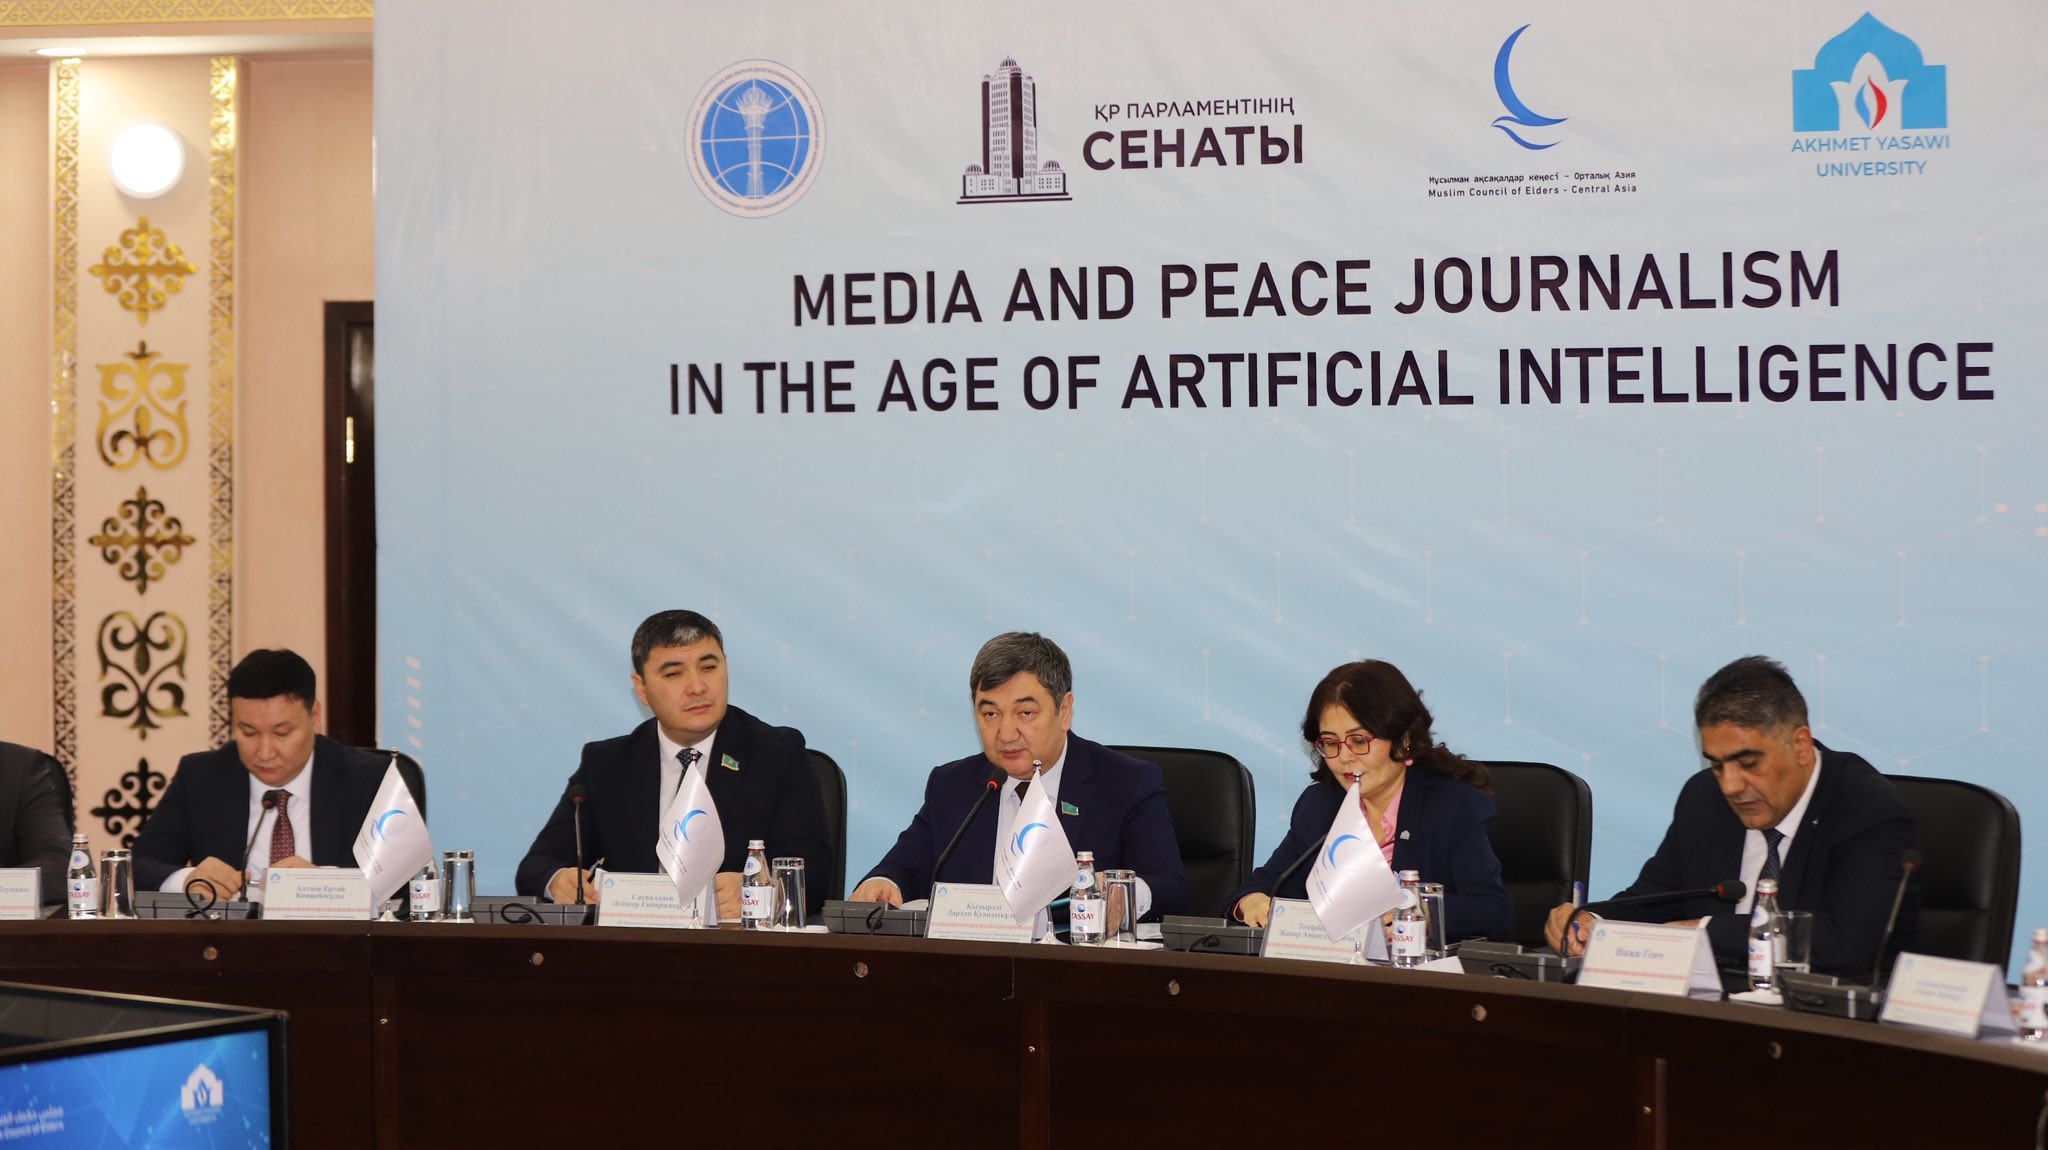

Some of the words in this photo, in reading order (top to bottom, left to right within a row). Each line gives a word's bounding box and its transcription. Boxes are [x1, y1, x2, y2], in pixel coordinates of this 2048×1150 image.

[1095, 104, 1120, 122] ҚР
[1127, 97, 1295, 118] ПАРЛАМЕНТІНІҢ
[1083, 124, 1303, 171] СЕНАТЫ
[1791, 137, 1871, 152] AKHMET
[1876, 134, 1950, 150] YASAWI
[1429, 176, 1470, 186] Мұсылман
[1574, 172, 1611, 181] Орталық
[1615, 171, 1636, 179] Азия
[1816, 160, 1927, 177] UNIVERSITY
[1428, 188, 1465, 198] Muslim
[1469, 187, 1508, 196] Council
[1511, 186, 1522, 195] of
[1525, 186, 1560, 195] Elders
[1571, 184, 1610, 194] Central
[1614, 184, 1637, 193] Asia
[795, 270, 983, 327] MEDIA
[1003, 266, 1134, 322] AND
[1162, 260, 1372, 319] PEACE
[1394, 250, 1840, 315] JOURNALISM
[670, 363, 723, 415] IN
[743, 361, 856, 414] THE
[877, 358, 999, 413] AGE
[1023, 356, 1101, 411] OF
[1121, 350, 1474, 409] ARTIFICIAL
[1500, 343, 1995, 405] INTELLIGENCE
